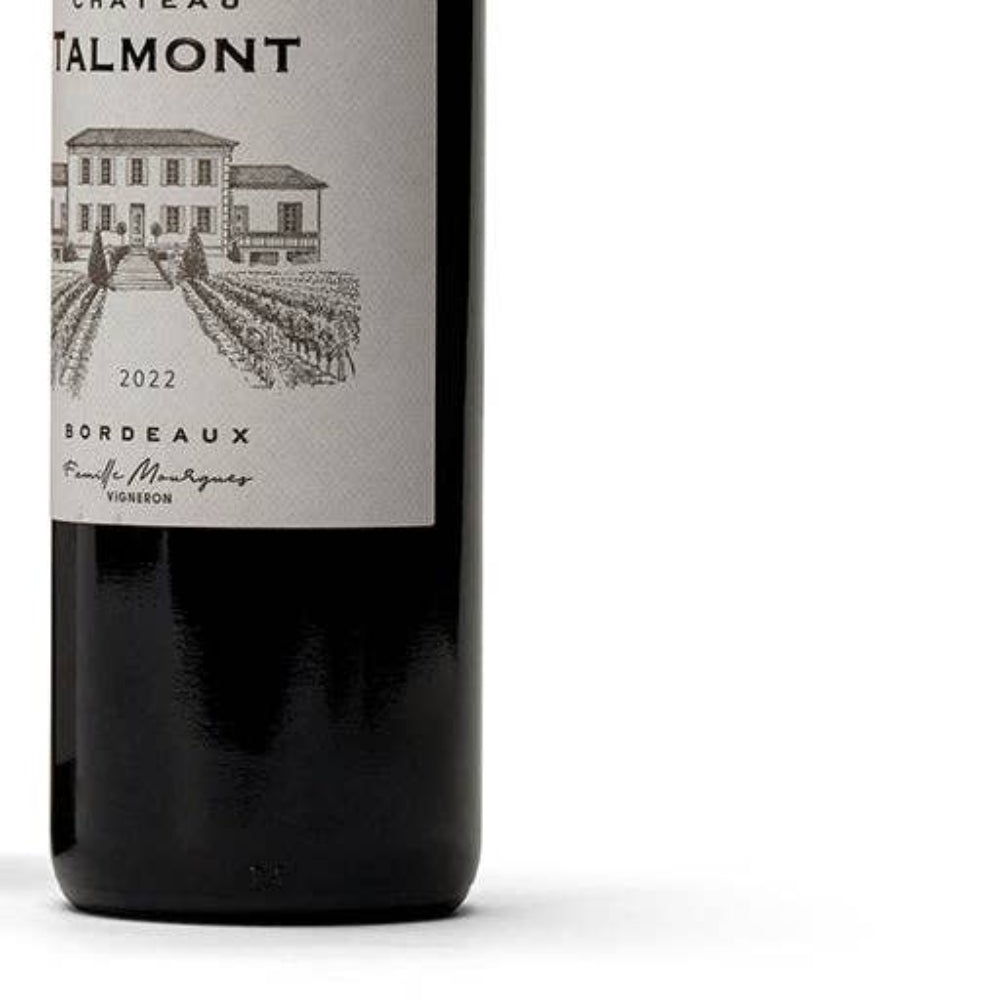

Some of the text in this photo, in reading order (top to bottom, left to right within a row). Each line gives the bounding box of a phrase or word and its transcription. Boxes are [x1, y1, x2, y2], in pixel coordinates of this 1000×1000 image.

[52, 31, 301, 73] TALMONT
[119, 368, 176, 389] 2022
[64, 422, 250, 445] BORDEAUX
